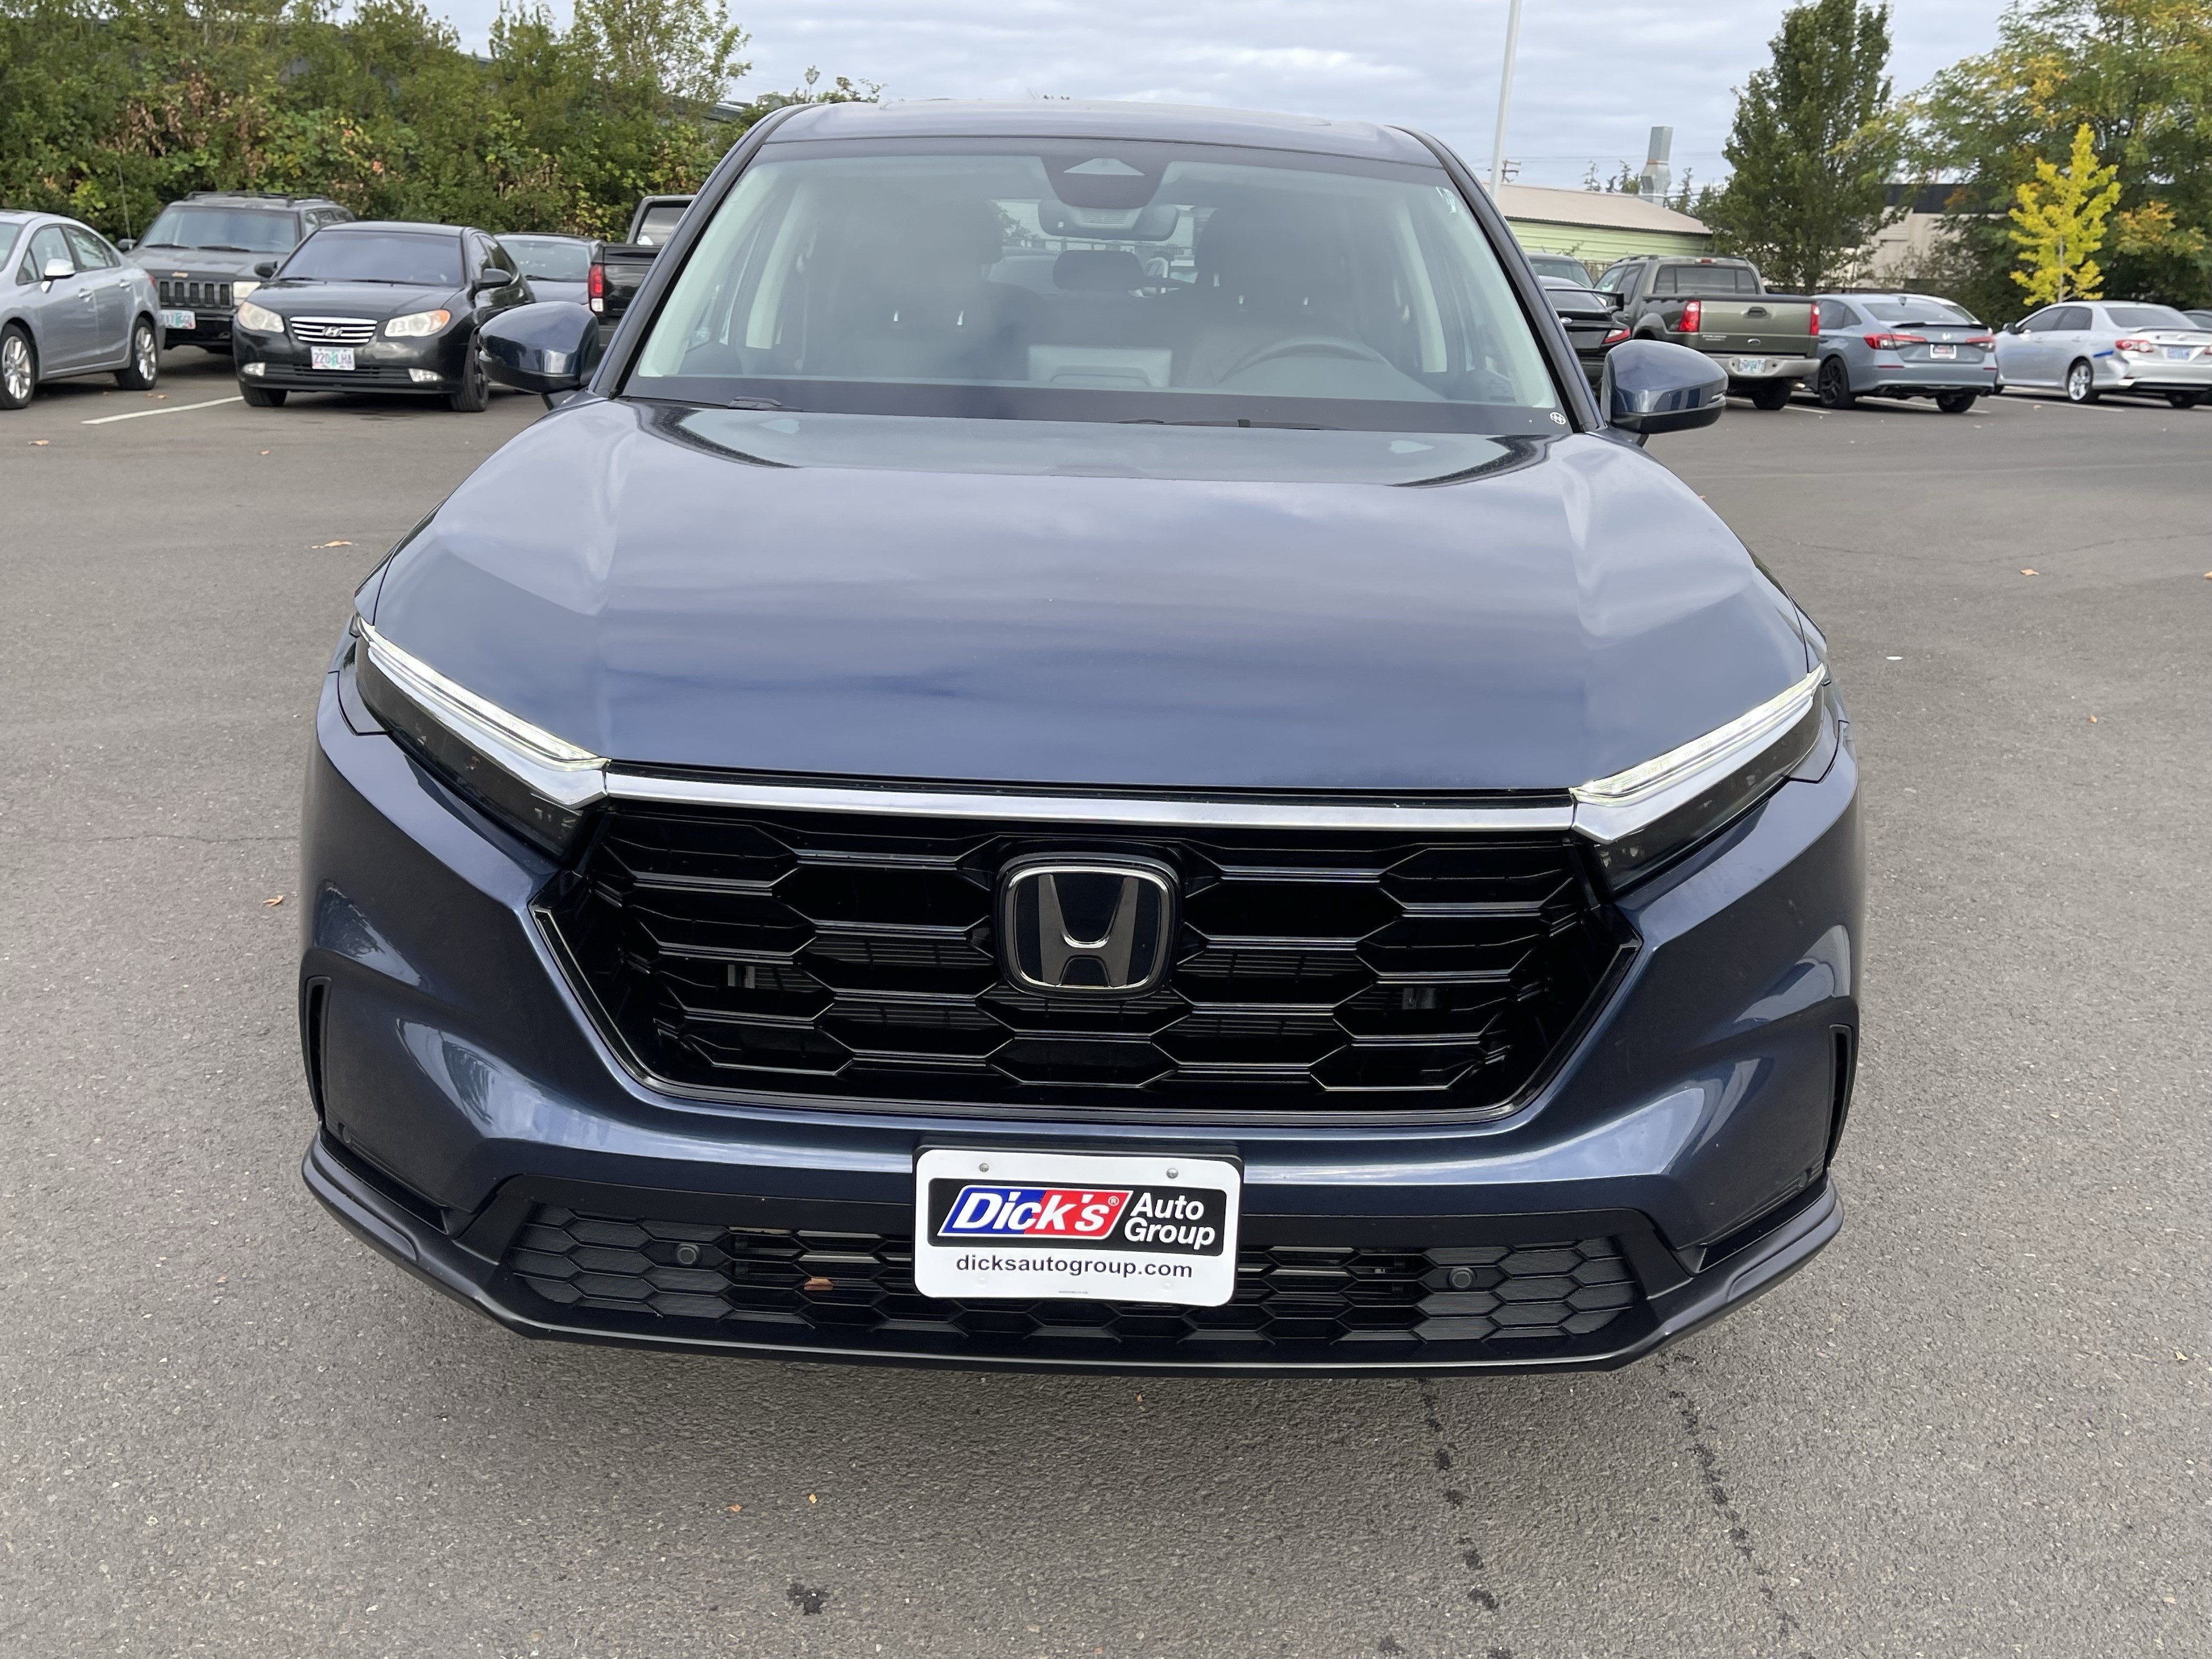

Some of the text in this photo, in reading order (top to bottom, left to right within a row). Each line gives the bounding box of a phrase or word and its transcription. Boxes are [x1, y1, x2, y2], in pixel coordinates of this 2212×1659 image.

[952, 1191, 1204, 1232] Dick's Auto
[1124, 1216, 1215, 1250] Group
[956, 1255, 1193, 1278] dicksautogroup.com
